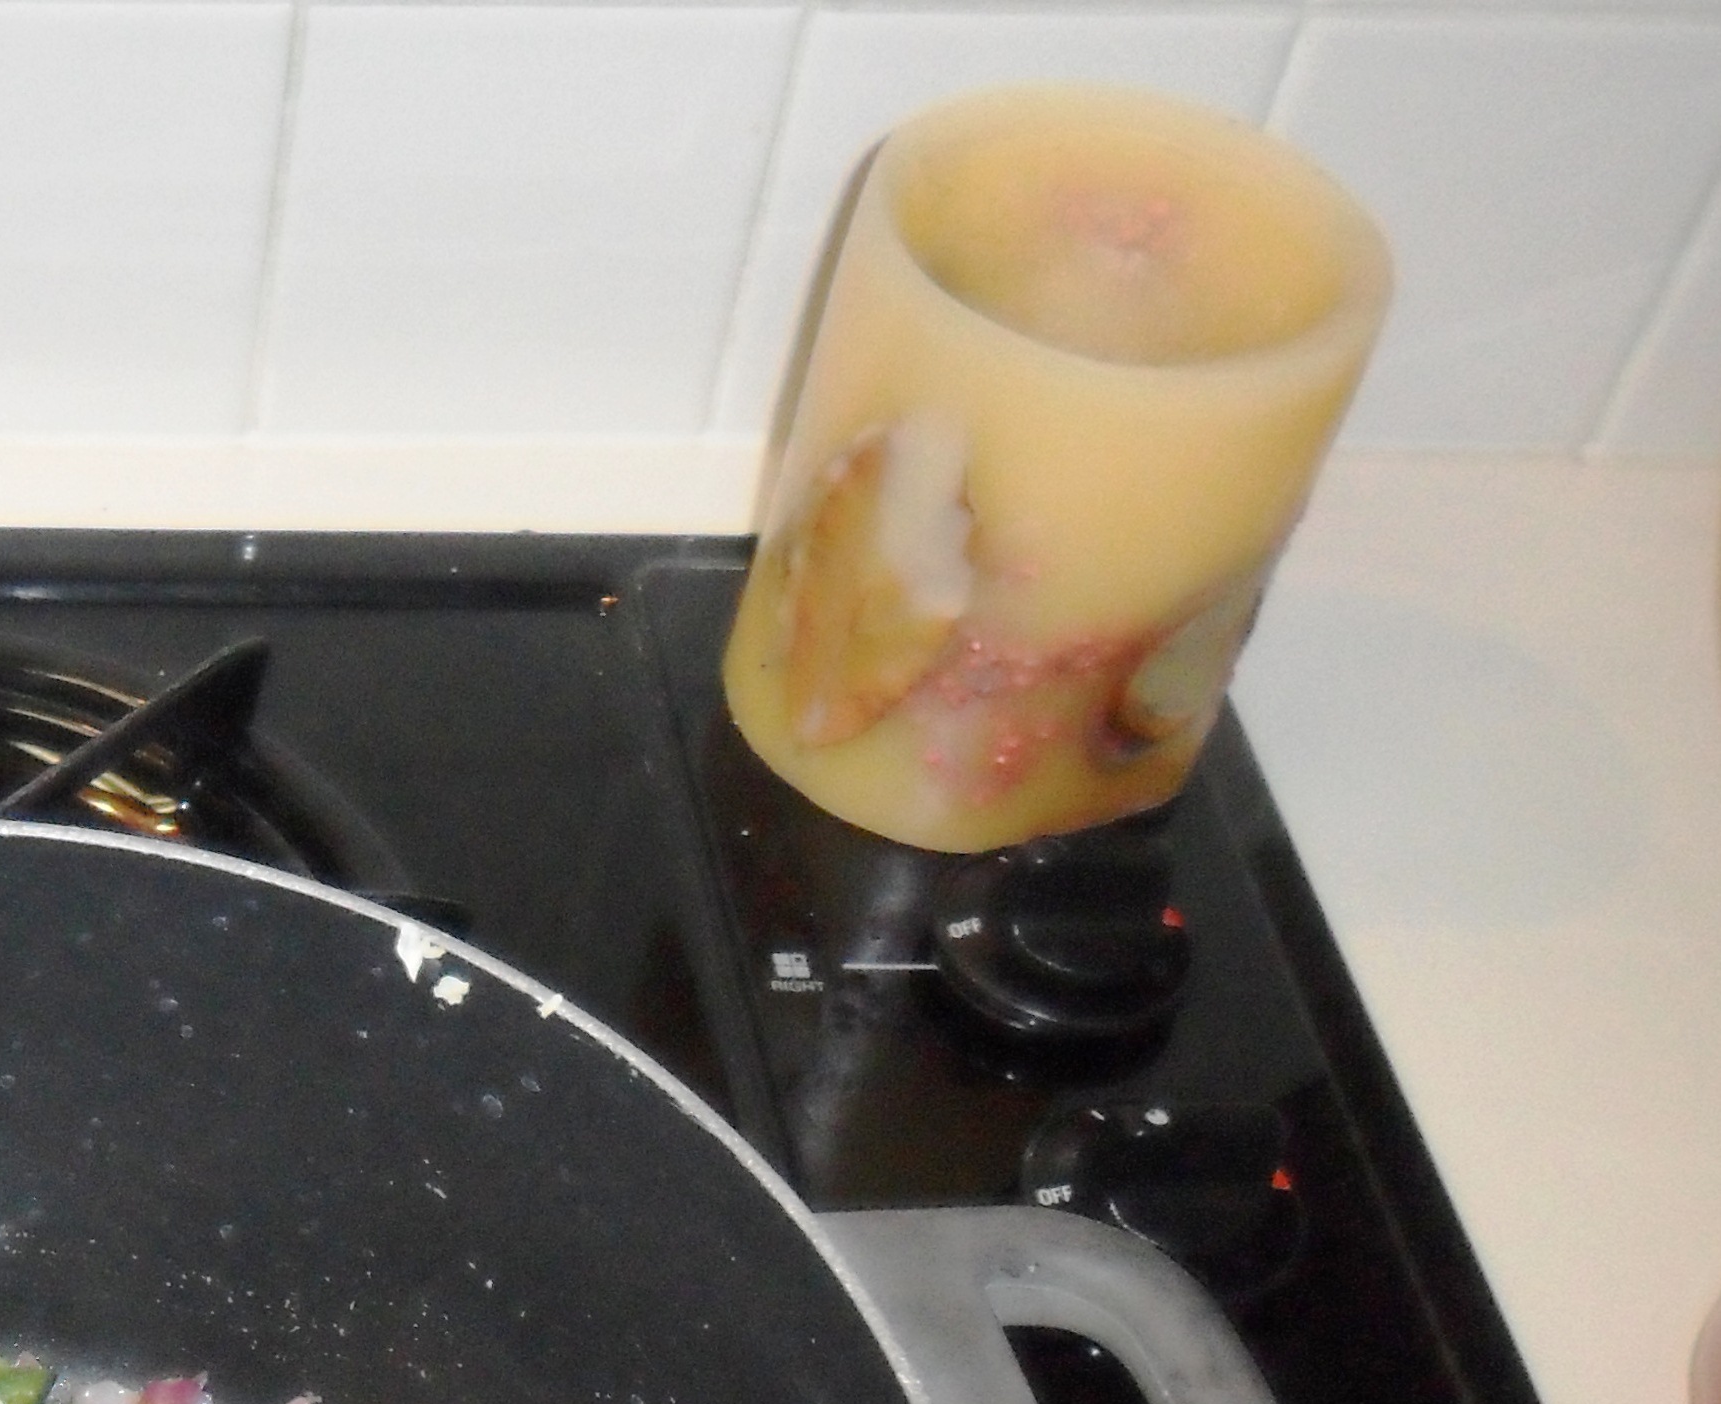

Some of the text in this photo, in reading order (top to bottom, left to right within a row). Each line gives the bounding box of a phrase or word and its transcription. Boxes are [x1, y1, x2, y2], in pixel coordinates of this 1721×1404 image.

[948, 917, 981, 938] OFF
[771, 980, 824, 992] RIGHT
[1038, 1185, 1071, 1206] OFF
